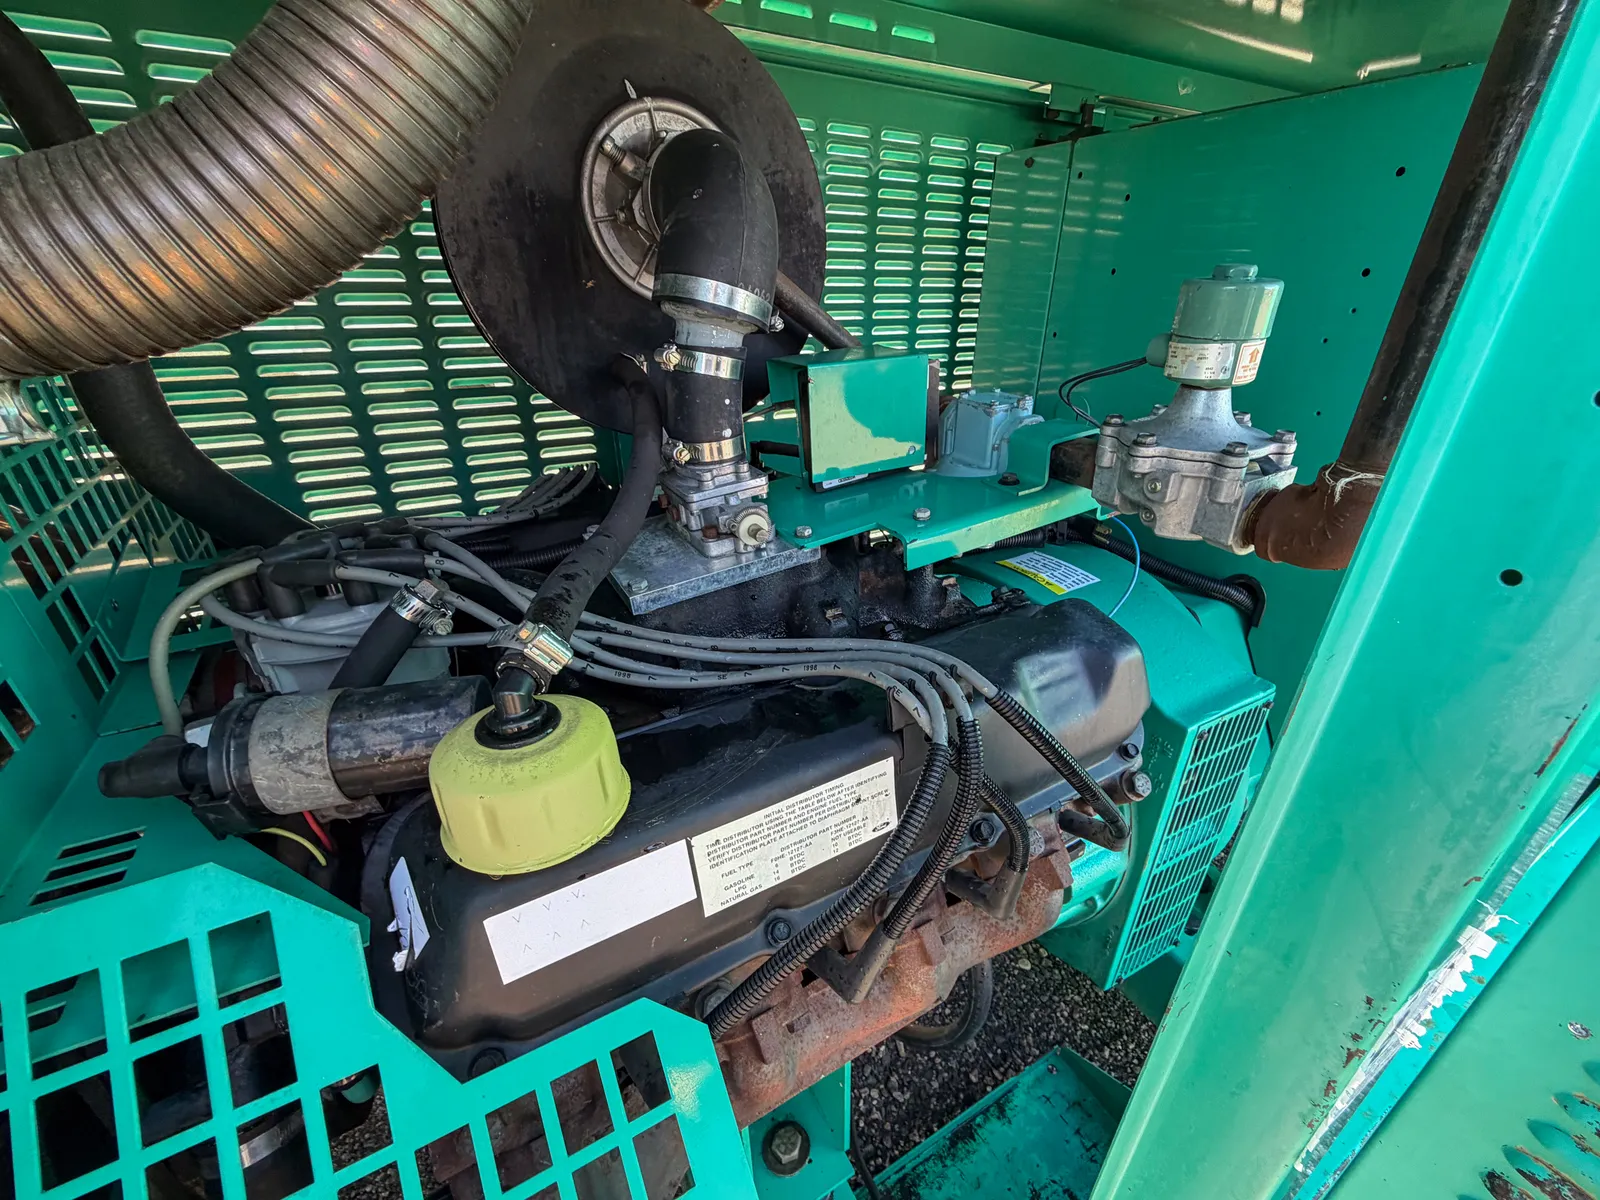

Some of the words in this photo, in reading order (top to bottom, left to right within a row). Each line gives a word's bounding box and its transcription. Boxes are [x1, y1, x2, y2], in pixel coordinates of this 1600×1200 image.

[706, 840, 722, 850] TIME
[723, 822, 764, 843] DISTRIBUTOR
[765, 815, 784, 826] USING
[798, 802, 814, 812] TABLE
[817, 793, 836, 804] BELOW
[837, 785, 854, 795] AFTER
[855, 771, 887, 788] IDENTIFYING
[707, 836, 748, 856] DISTRIBUTOR
[750, 829, 765, 838] PART
[767, 817, 792, 831] NUMBER
[794, 812, 806, 820] AND
[807, 803, 828, 814] ENGINE
[829, 797, 842, 806] FUEL
[708, 850, 730, 863] VERIFY
[732, 833, 772, 853] DISTRIBUTOR
[773, 825, 788, 835] PART
[789, 815, 813, 829] NUMBER
[814, 810, 826, 818] PER
[827, 794, 862, 814] DISTRIBUTOR
[764, 808, 784, 819] INITIAL
[786, 792, 823, 810] DISTRIBUTOR
[824, 782, 844, 794] TIMING
[709, 846, 758, 870] IDENTIFICATION
[760, 836, 778, 848] PLATE
[779, 822, 808, 840] ATTACHED
[818, 806, 850, 822] DIAPHRAGM
[871, 789, 889, 800] SCREW
[780, 832, 818, 852] DISTRIBUTOR
[819, 827, 832, 835] PART
[833, 815, 856, 828] NUMBER
[831, 834, 842, 842] NOT
[843, 823, 866, 836] USEABLE
[720, 890, 748, 906] NATURAL
[750, 884, 762, 893] GAS
[790, 863, 806, 874] BTDC
[721, 869, 737, 878] FUEL
[738, 861, 753, 870] TYPE
[724, 874, 755, 891] GASOLINE
[789, 851, 805, 861] BTDC
[847, 830, 862, 840] BTDC
[734, 885, 747, 893] LPG
[790, 857, 805, 868] BTDC
[848, 837, 862, 847] BTDC
